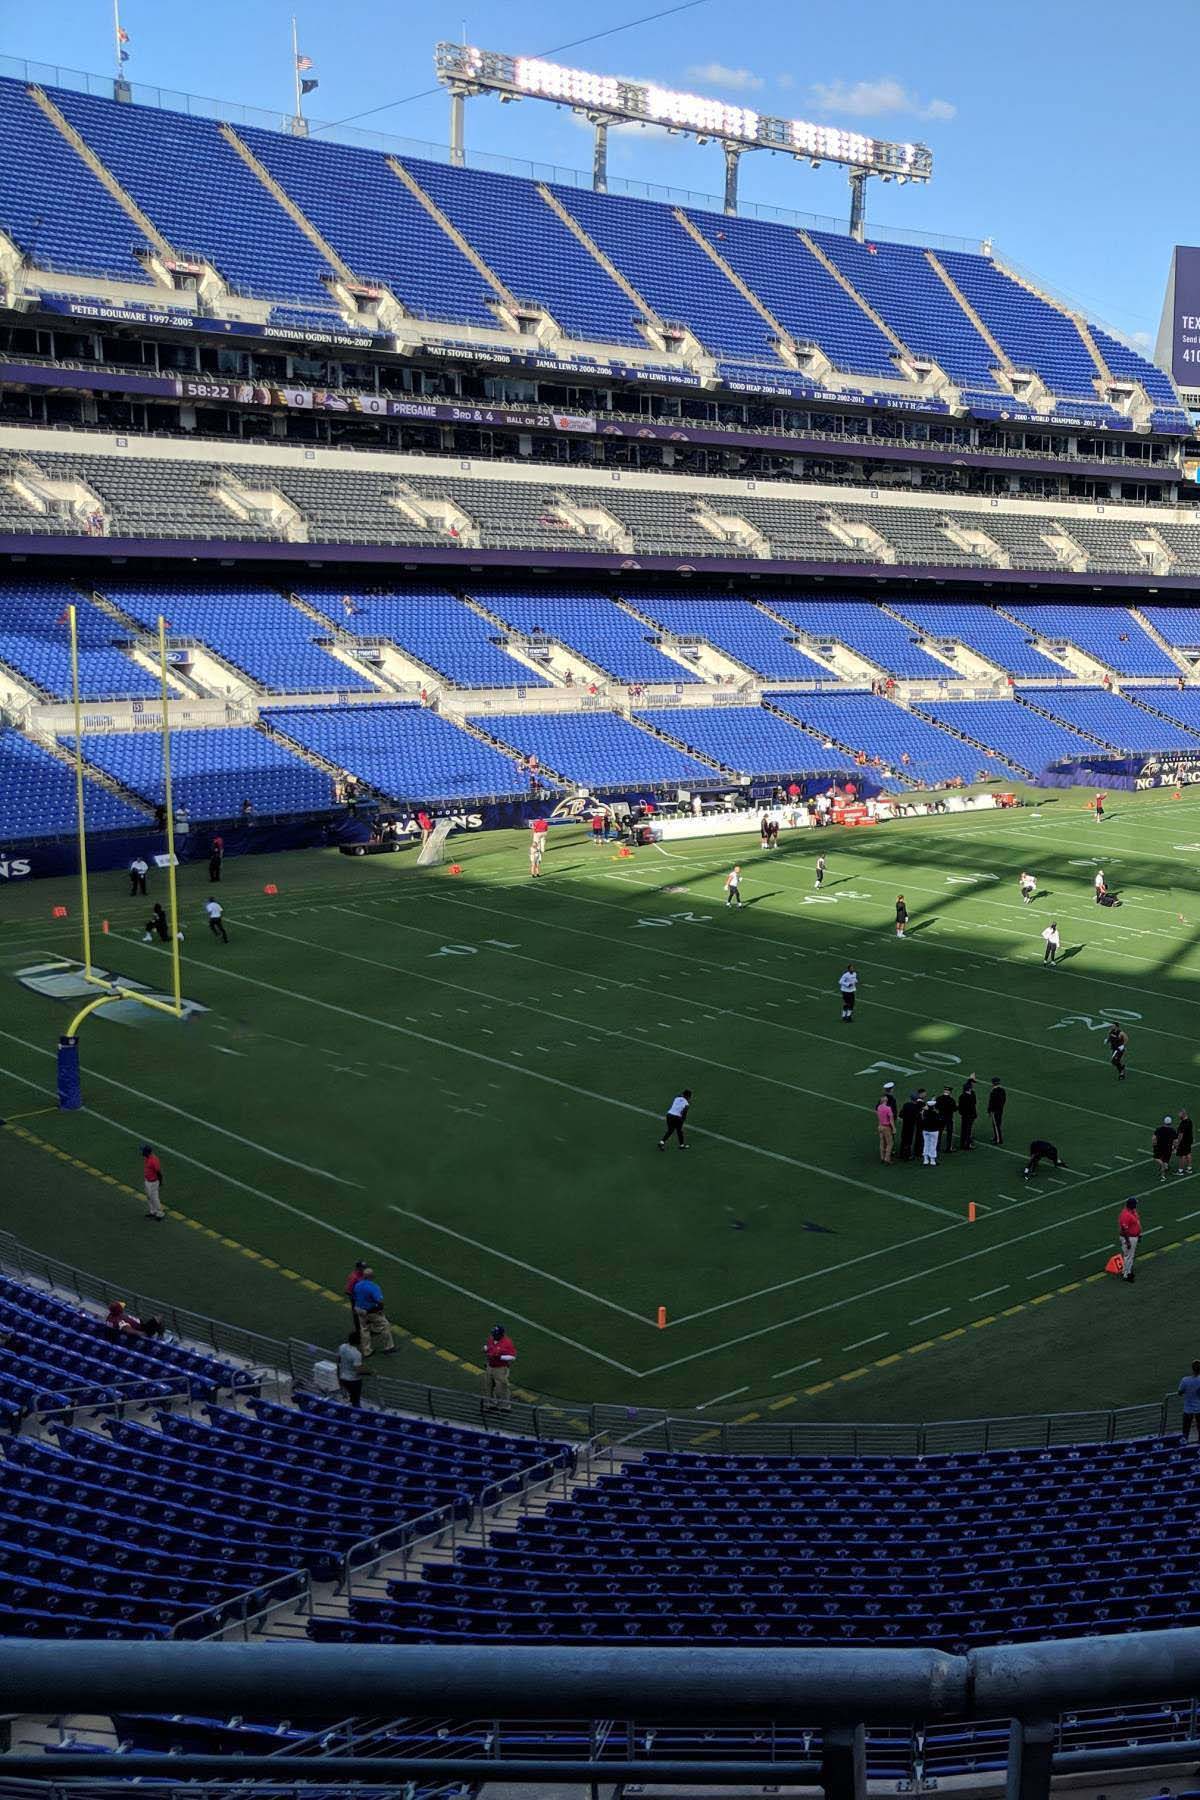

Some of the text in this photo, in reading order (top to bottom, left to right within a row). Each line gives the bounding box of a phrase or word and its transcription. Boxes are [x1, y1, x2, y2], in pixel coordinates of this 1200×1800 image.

[71, 304, 193, 327] PETER BOULWARE 1997-2005
[264, 327, 373, 347] JONATHAN OGDEN 1996-2007
[1182, 335, 1197, 343] Send
[427, 346, 446, 356] MATT
[448, 349, 473, 359] STOVER
[536, 360, 557, 369] JAMAL
[558, 363, 578, 371] LEWIS
[649, 373, 667, 382] LEWIS
[188, 384, 230, 398] 58:22
[295, 393, 304, 407] 0
[370, 400, 379, 412] 0
[393, 403, 437, 416] PREGAME
[473, 410, 483, 421] &
[486, 411, 494, 422] 4
[507, 416, 523, 425] BALL
[537, 415, 550, 427] 25
[1031, 415, 1049, 423] WORLD
[1051, 417, 1080, 425] CHAMPIONS
